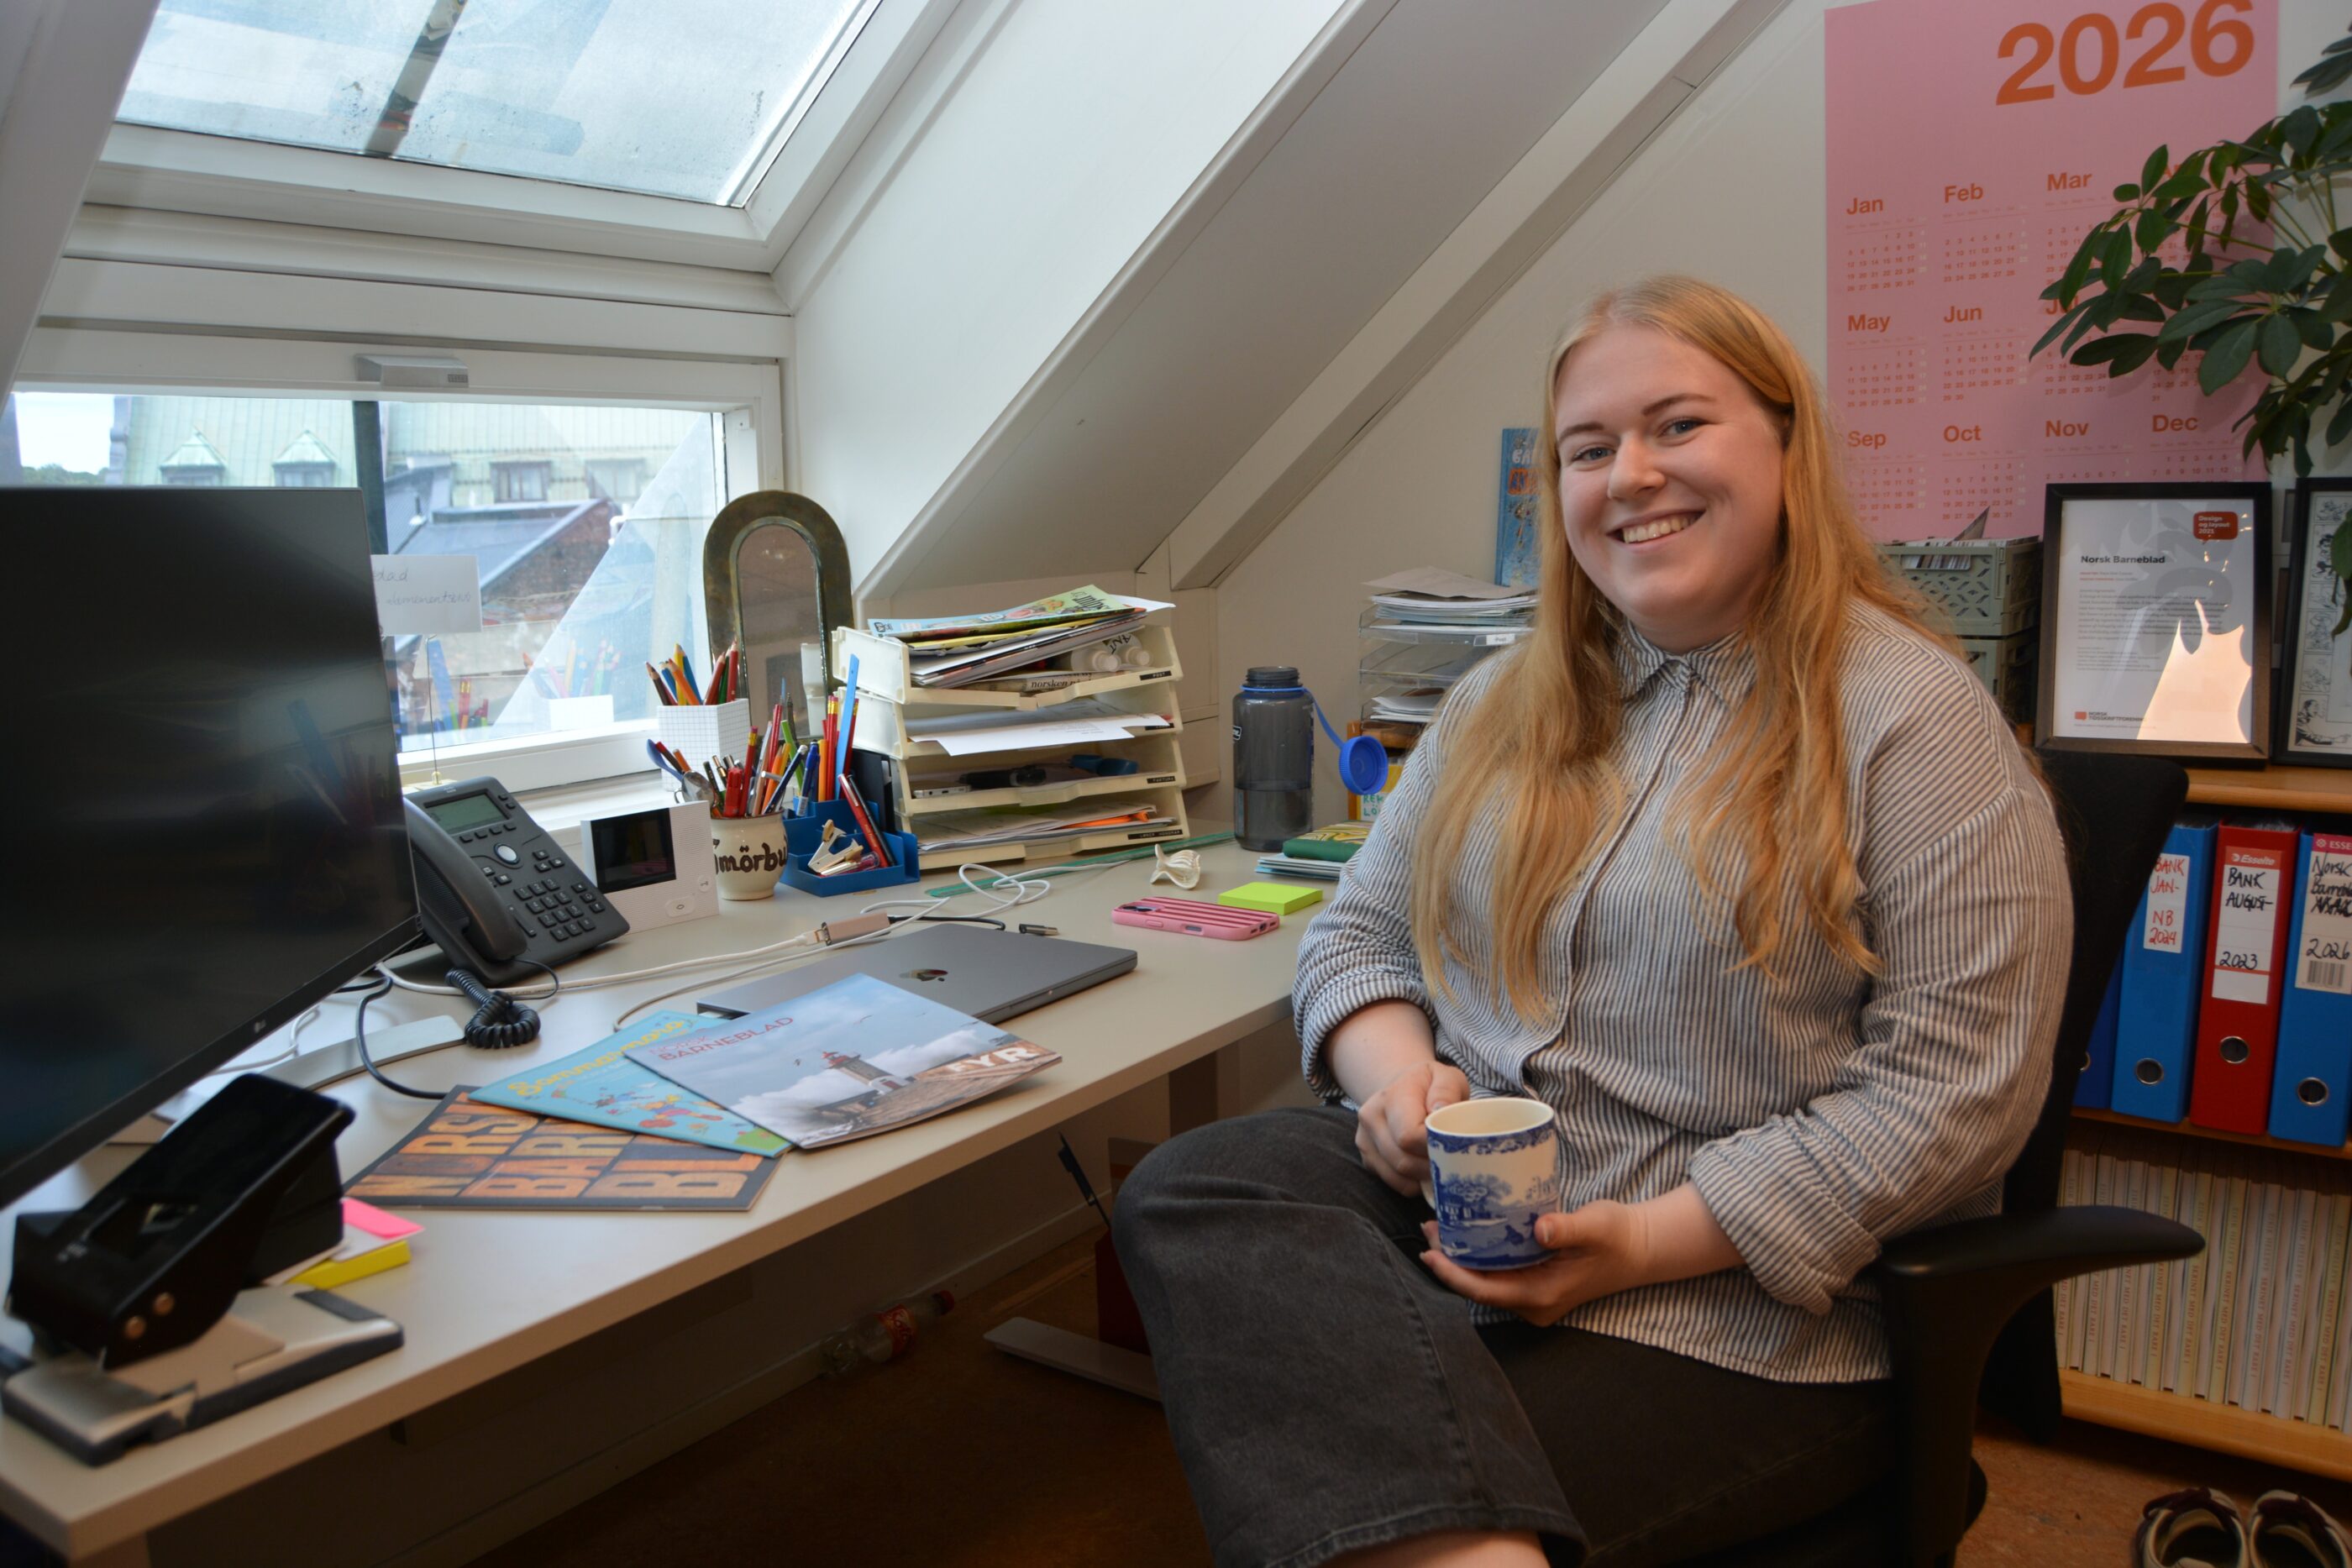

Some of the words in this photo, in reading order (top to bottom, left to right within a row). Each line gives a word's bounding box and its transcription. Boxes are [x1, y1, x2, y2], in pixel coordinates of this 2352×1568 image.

[1995, 0, 2255, 106] 2026
[2048, 172, 2092, 191] Mar
[1945, 183, 1983, 203] Feb
[1846, 198, 1882, 214] Jan
[1848, 314, 1890, 333] May
[1944, 306, 1982, 323] Jun
[2046, 421, 2088, 437] Nov
[2152, 415, 2197, 432] Dec
[1848, 431, 1886, 449] Sep
[1944, 426, 1981, 442] Oct
[2081, 555, 2111, 564] Norsk
[2113, 555, 2166, 564] Barneblad
[1031, 679, 1068, 688] norsken
[2155, 857, 2185, 876] BANK
[2241, 855, 2276, 865] Esselte
[2228, 867, 2266, 889] BANK
[2306, 938, 2350, 960] 2026
[2218, 952, 2258, 970] 2023
[659, 1017, 794, 1061] BARNEBLAD
[945, 1047, 1040, 1072] FYR
[2190, 1265, 2199, 1298] SKRINET
[2223, 1272, 2232, 1303] SKRINET
[2258, 1277, 2269, 1310] SKRINET
[2292, 1284, 2301, 1317] SKRINET
[2187, 1301, 2196, 1317] MED
[2220, 1307, 2229, 1324] MED
[2324, 1290, 2336, 1324] SKRINET
[2256, 1314, 2265, 1330] MED
[2288, 1320, 2297, 1338] MED
[2323, 1327, 2331, 1344] MED
[2319, 1347, 2328, 1364] DET
